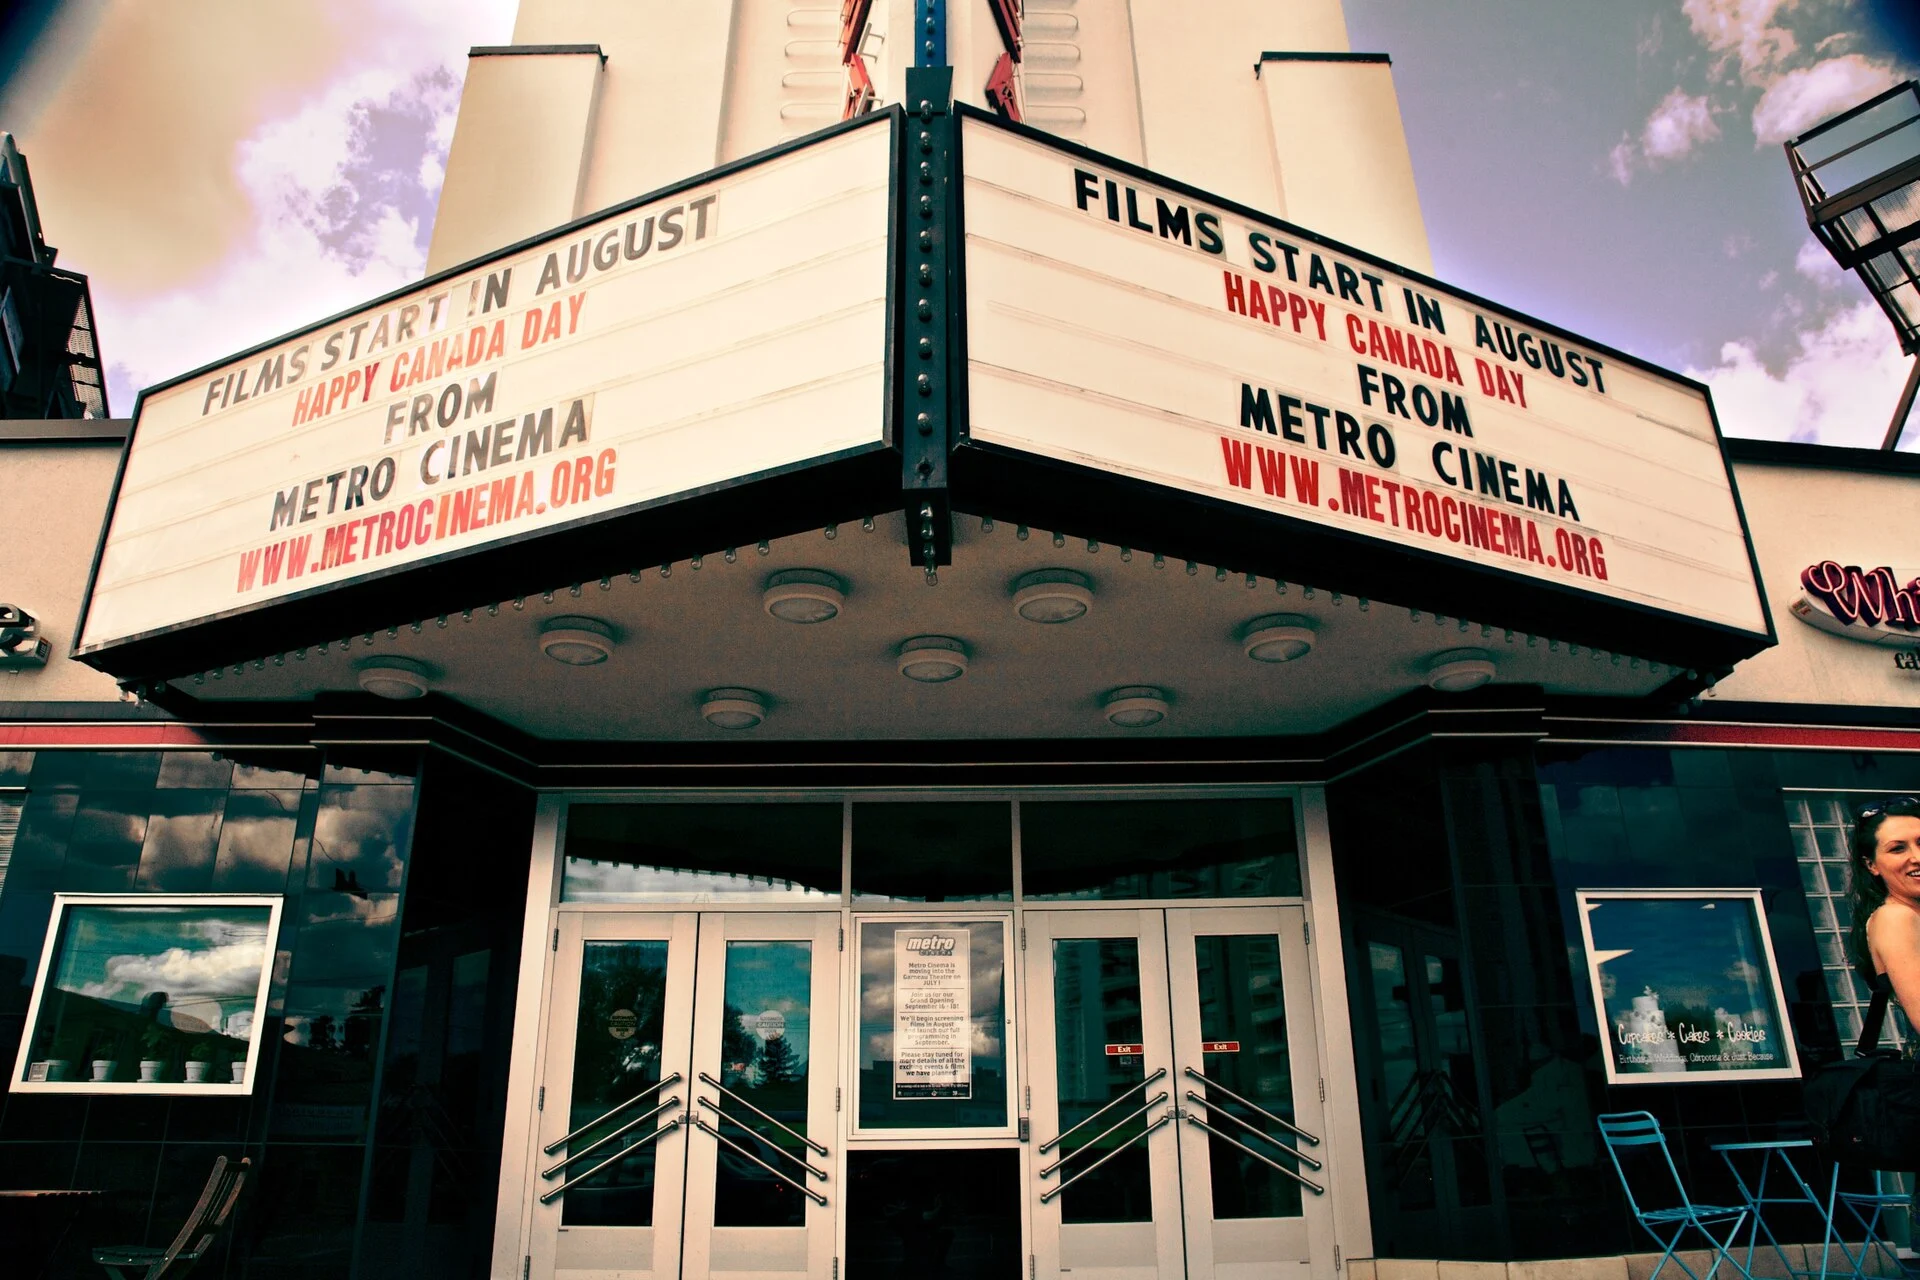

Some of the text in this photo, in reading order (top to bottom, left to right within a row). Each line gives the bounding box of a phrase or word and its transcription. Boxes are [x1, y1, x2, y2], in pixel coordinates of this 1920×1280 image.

[202, 194, 716, 416] FILMS START IN AUGUST
[1074, 168, 1606, 394] FILMS START IN AUGUST
[292, 291, 587, 427] HAPPY CANADA DAY
[1223, 270, 1528, 409] HAPPY CANADA DAY
[384, 371, 497, 445] FROM
[1240, 382, 1581, 522] METRO CINEMA
[1357, 363, 1474, 438] FROM
[269, 399, 588, 532] METRO CINEMA
[237, 447, 617, 593] WWW.METROCINEMA.ORG
[1801, 561, 1920, 631] Wh
[906, 935, 956, 951] metro
[1117, 1045, 1131, 1053] Exit
[1618, 1021, 1766, 1047] Cupcakes Cakes Cookies
[1747, 1051, 1774, 1061] Because
